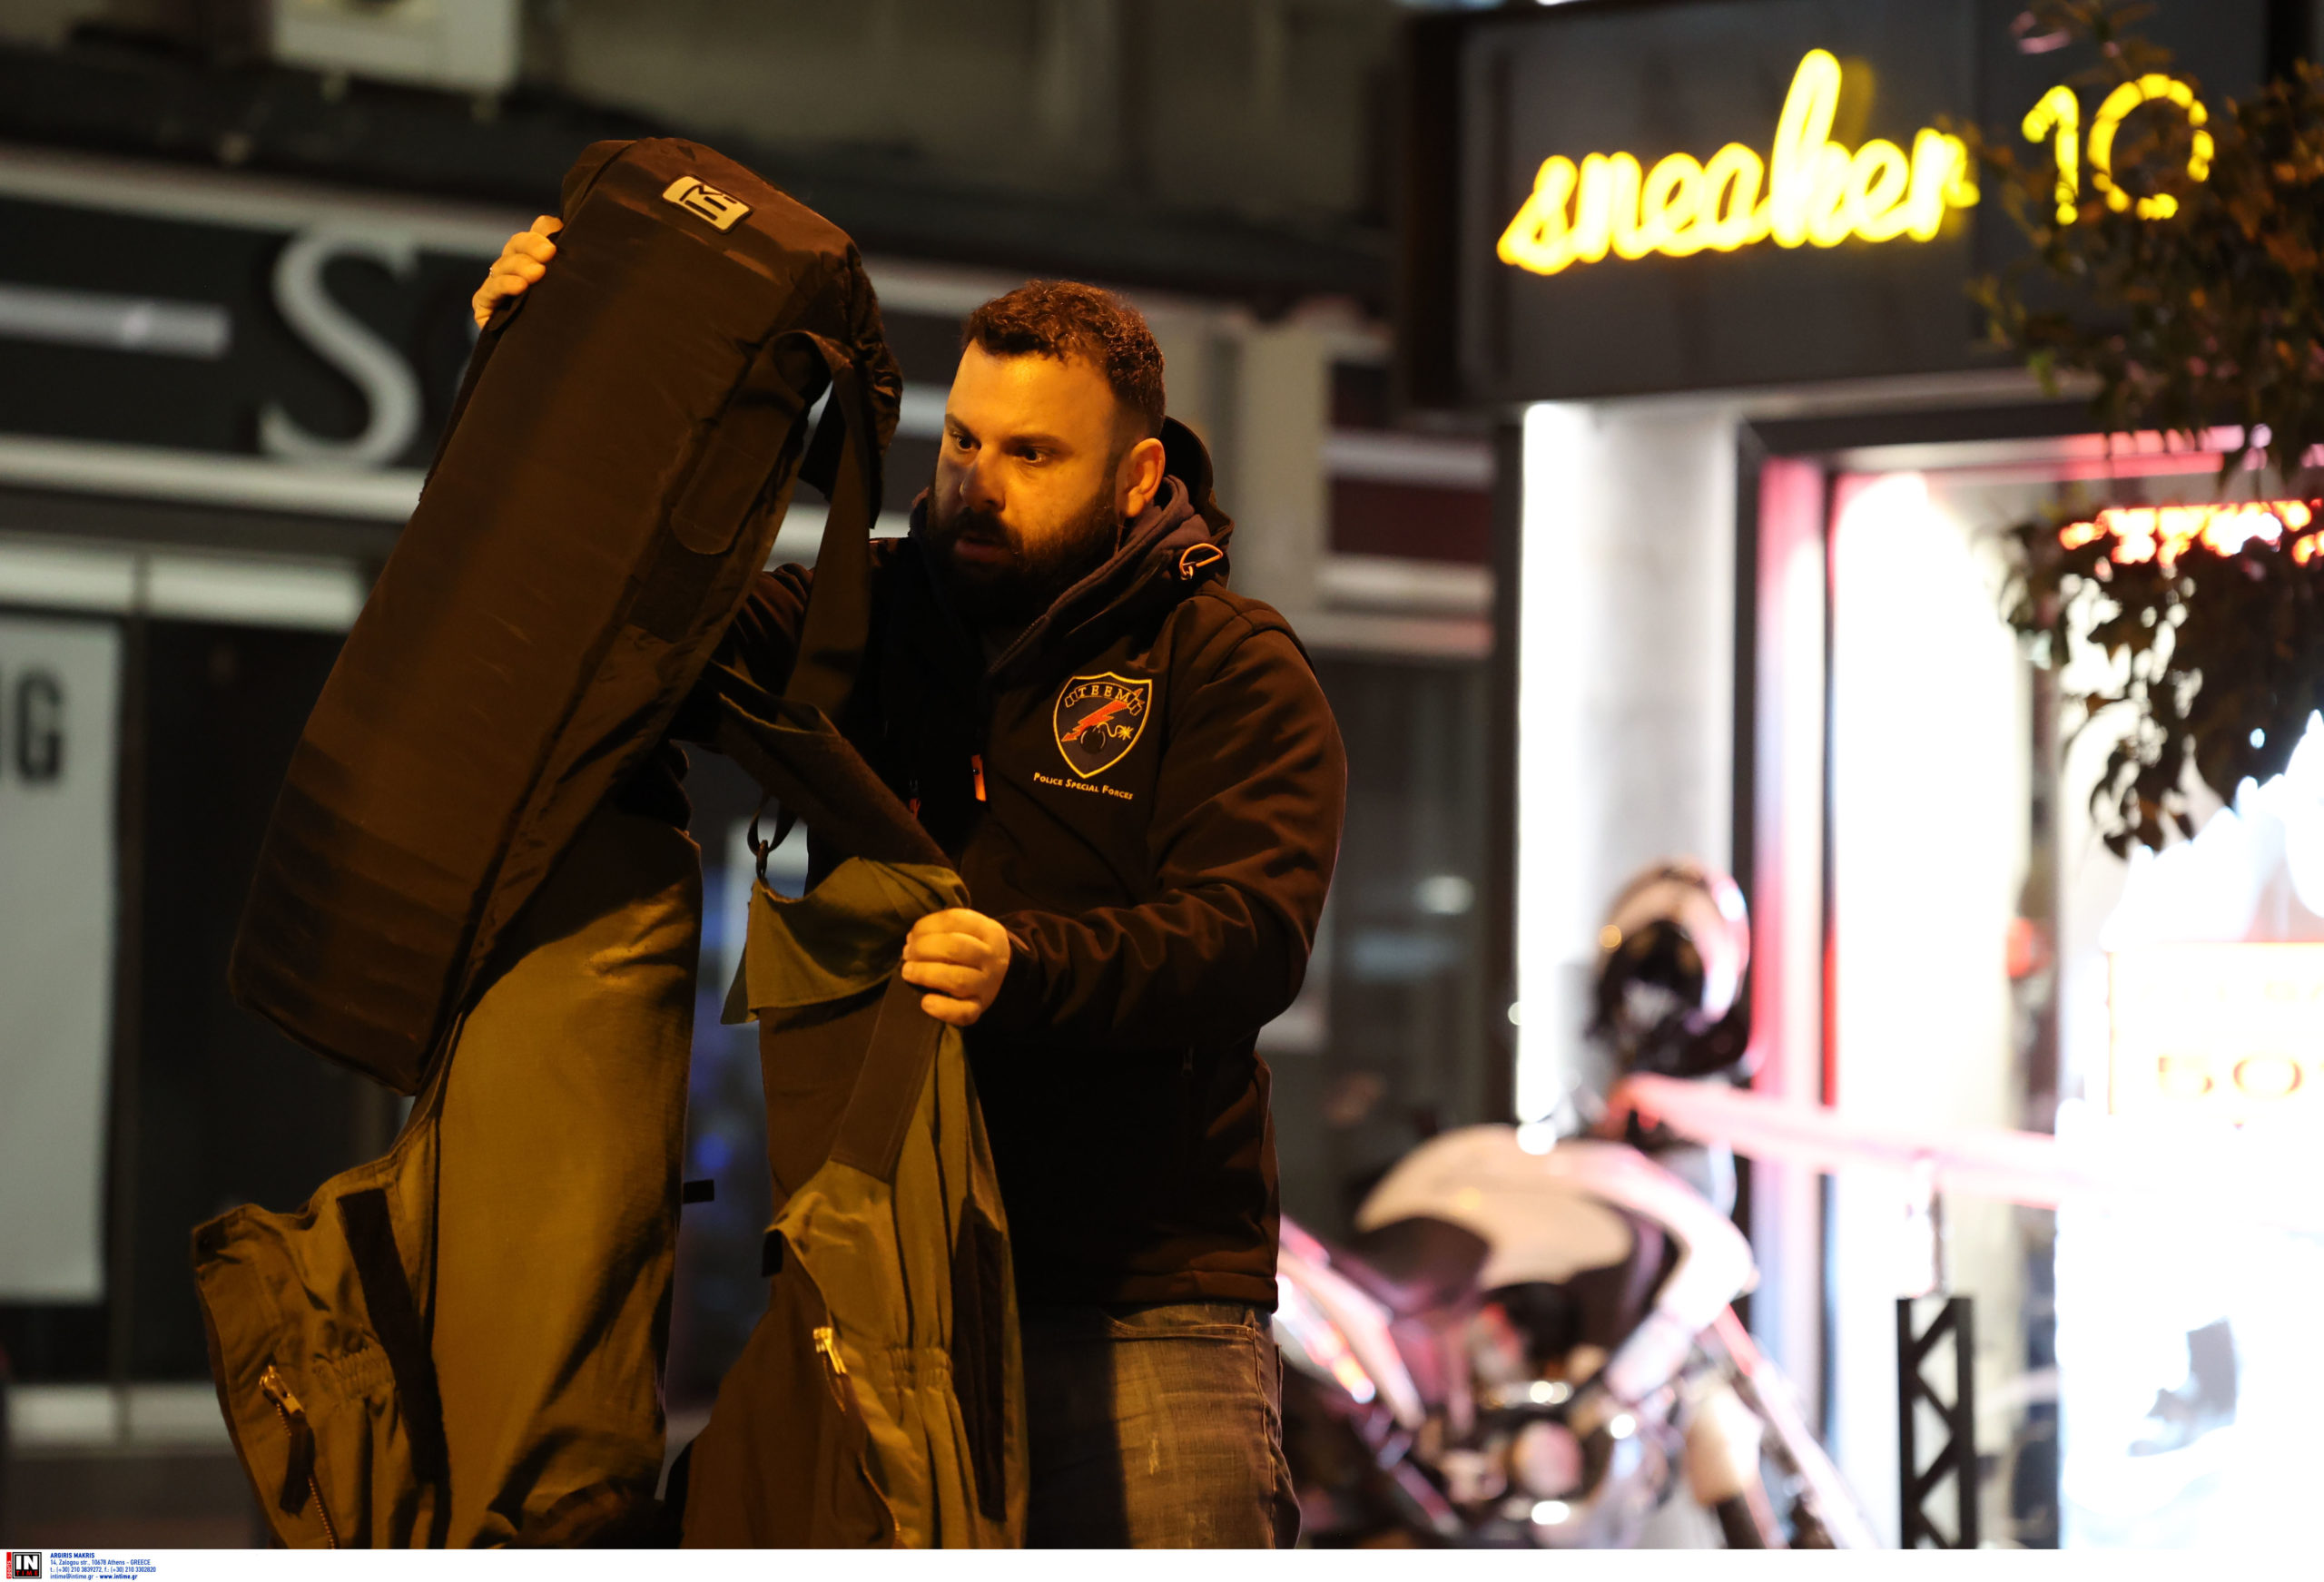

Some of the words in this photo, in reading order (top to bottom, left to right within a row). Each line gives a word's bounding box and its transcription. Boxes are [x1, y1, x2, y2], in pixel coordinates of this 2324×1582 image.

[1498, 48, 1980, 275] sneaker
[2022, 73, 2214, 226] 10
[1078, 684, 1129, 703] TEEM
